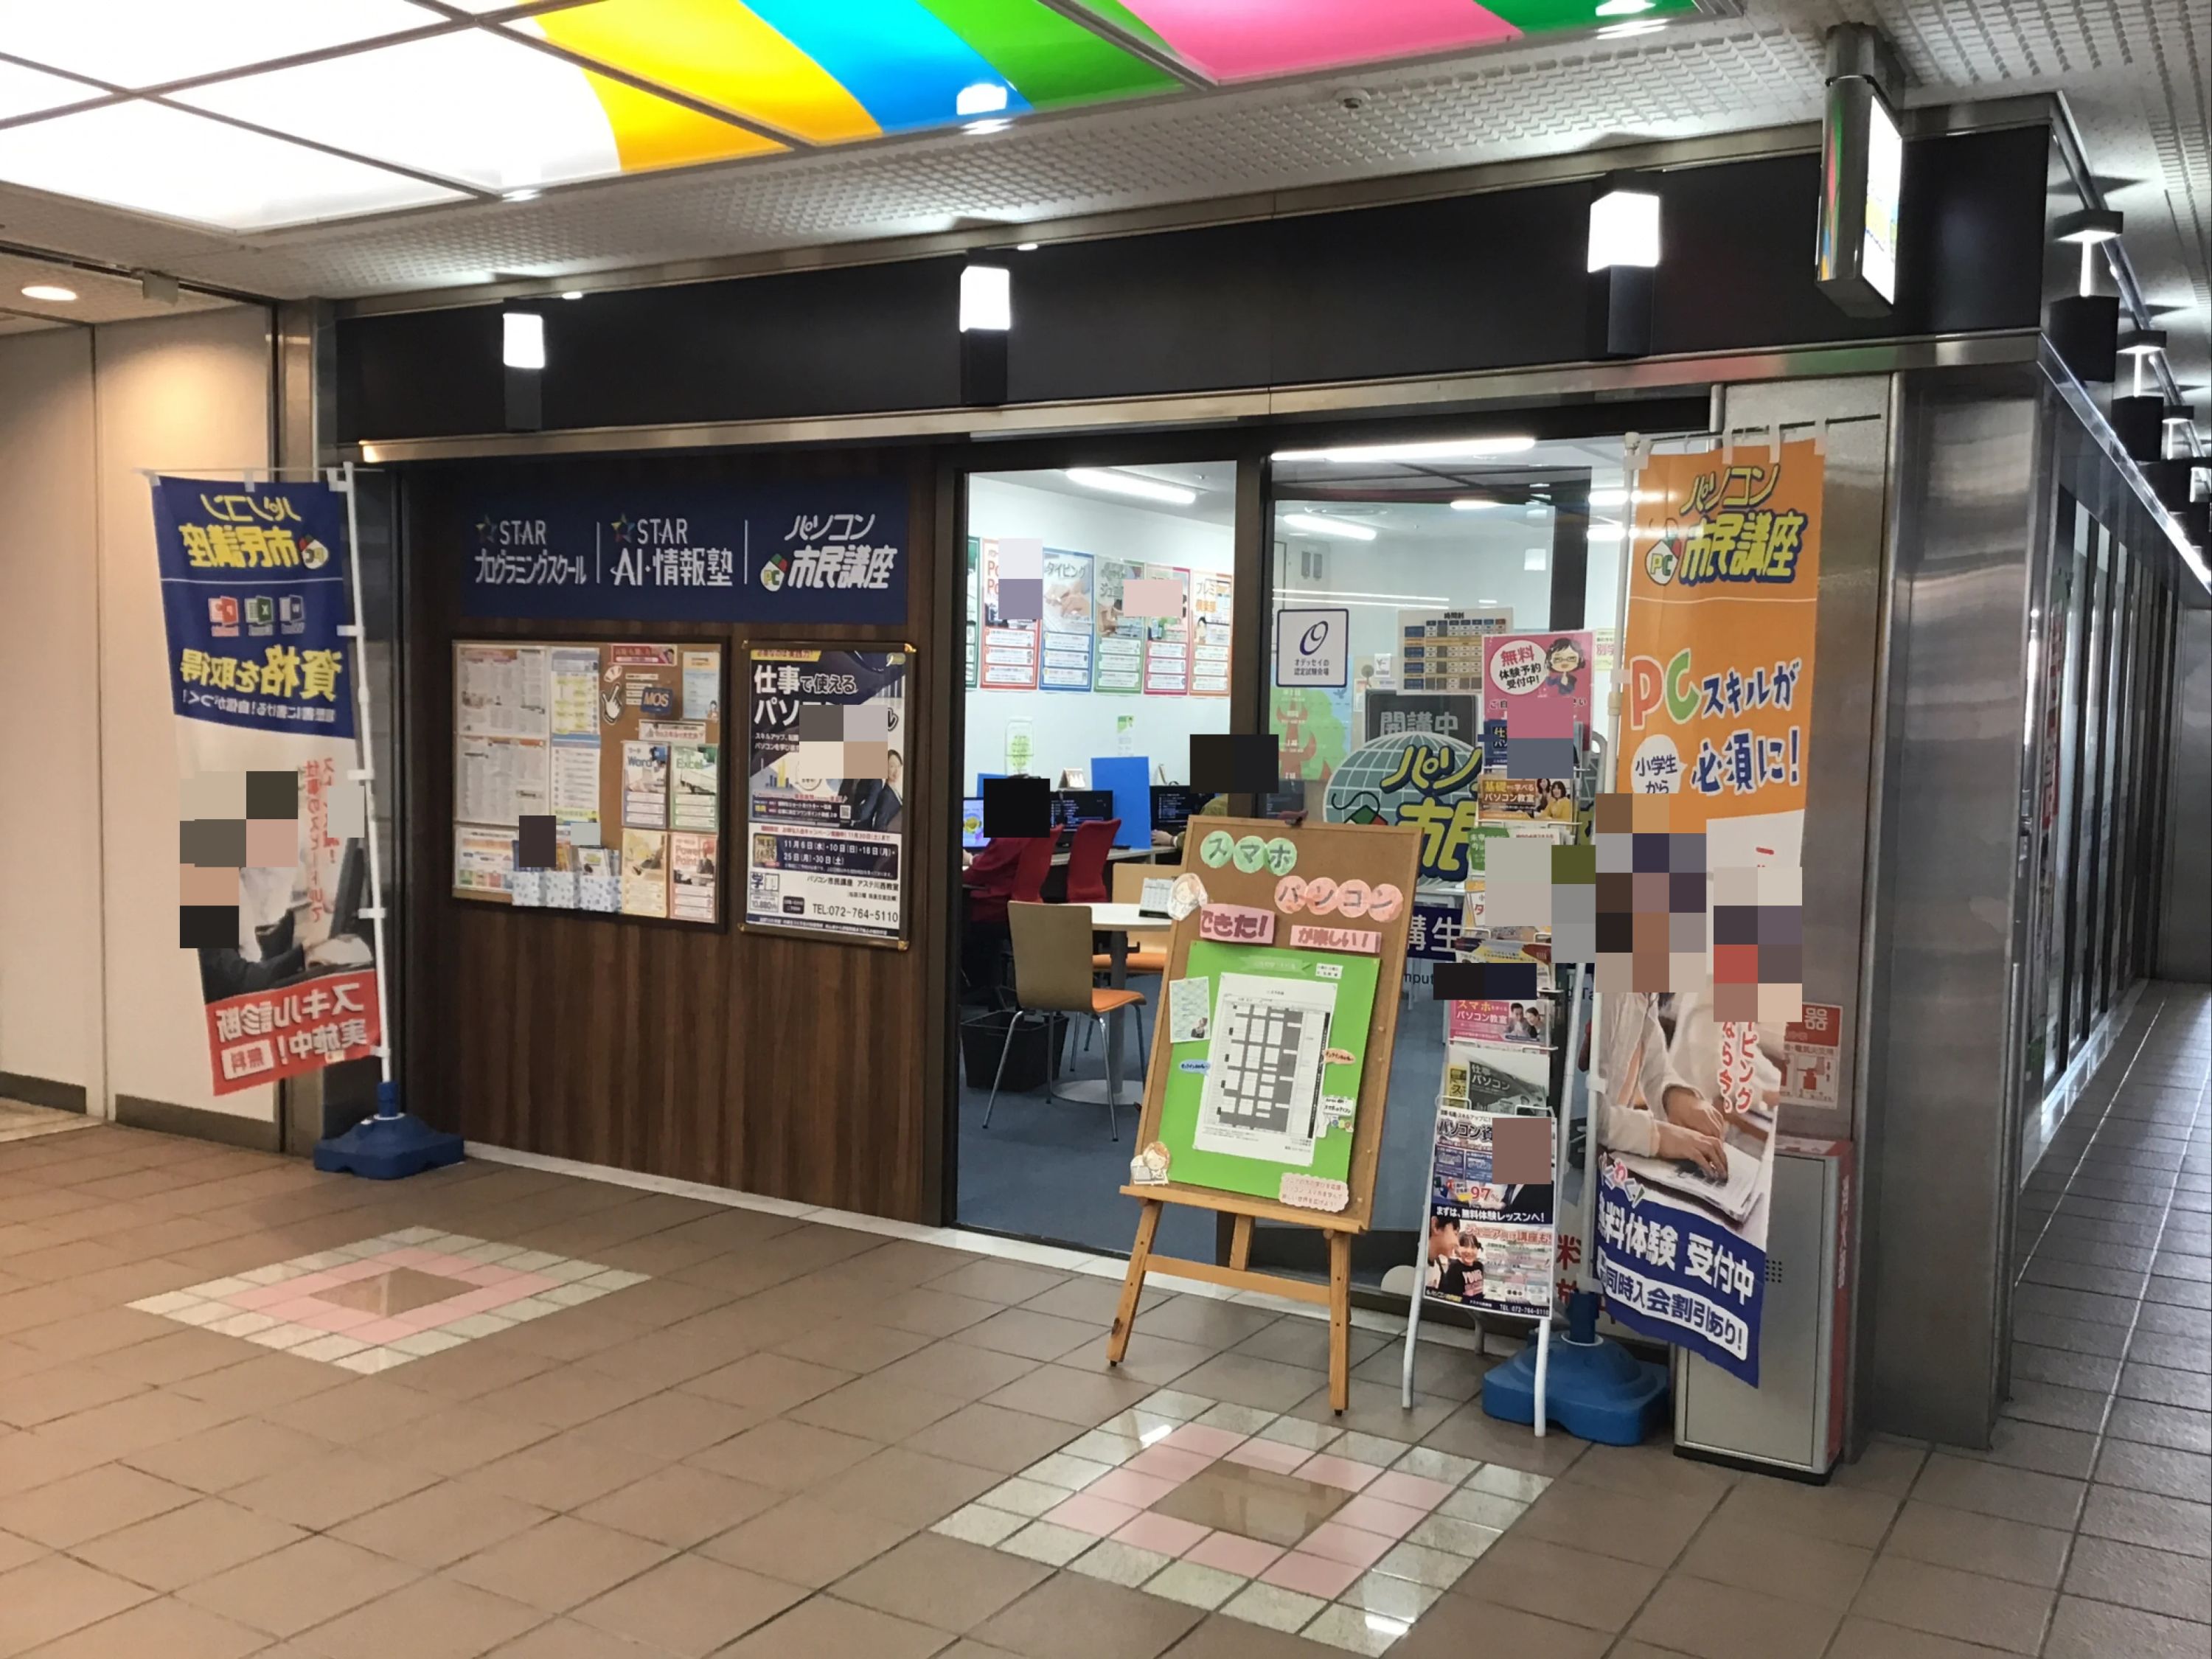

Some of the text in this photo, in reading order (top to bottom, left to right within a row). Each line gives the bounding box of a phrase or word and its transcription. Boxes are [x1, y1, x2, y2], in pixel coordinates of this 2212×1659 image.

[1680, 465, 1781, 515] パソコン
[499, 520, 546, 545] STAR
[637, 518, 688, 544] STAR
[785, 515, 876, 541] パソコン
[1679, 508, 1809, 586] 市民講座
[475, 549, 587, 585] プログラミングスクール
[787, 545, 898, 589] 市民講座
[1649, 553, 1674, 577] PC
[763, 570, 780, 586] PC
[1444, 611, 1465, 619] 時間割
[1500, 644, 1534, 665] 無料
[754, 664, 858, 695] 仕事で使える
[1293, 667, 1329, 677] 認定試験会場
[1499, 664, 1542, 681] 体験予約
[1506, 677, 1540, 690] 受付中!
[644, 691, 669, 707] MOS
[1630, 647, 1802, 730] PCスキルが
[1380, 710, 1458, 739] 開講中
[627, 756, 653, 768] Word
[1380, 745, 1482, 792] パソ
[1635, 754, 1678, 777] 小学生
[1690, 725, 1800, 796] 必須に!
[1484, 793, 1535, 803] パソコン教室
[1645, 780, 1670, 793] から
[1208, 838, 1291, 869] スマホ
[1278, 886, 1394, 912] パソコン
[1201, 910, 1269, 938] できた!
[1297, 927, 1369, 948] が楽しい!
[1456, 1010, 1508, 1025] パソコン教室
[1471, 1074, 1510, 1091] パソコン
[1436, 1120, 1492, 1141] パソコン資
[1436, 1206, 1545, 1223] まずは、無料体験レッスンへ!
[1684, 1231, 1755, 1305] 受付中
